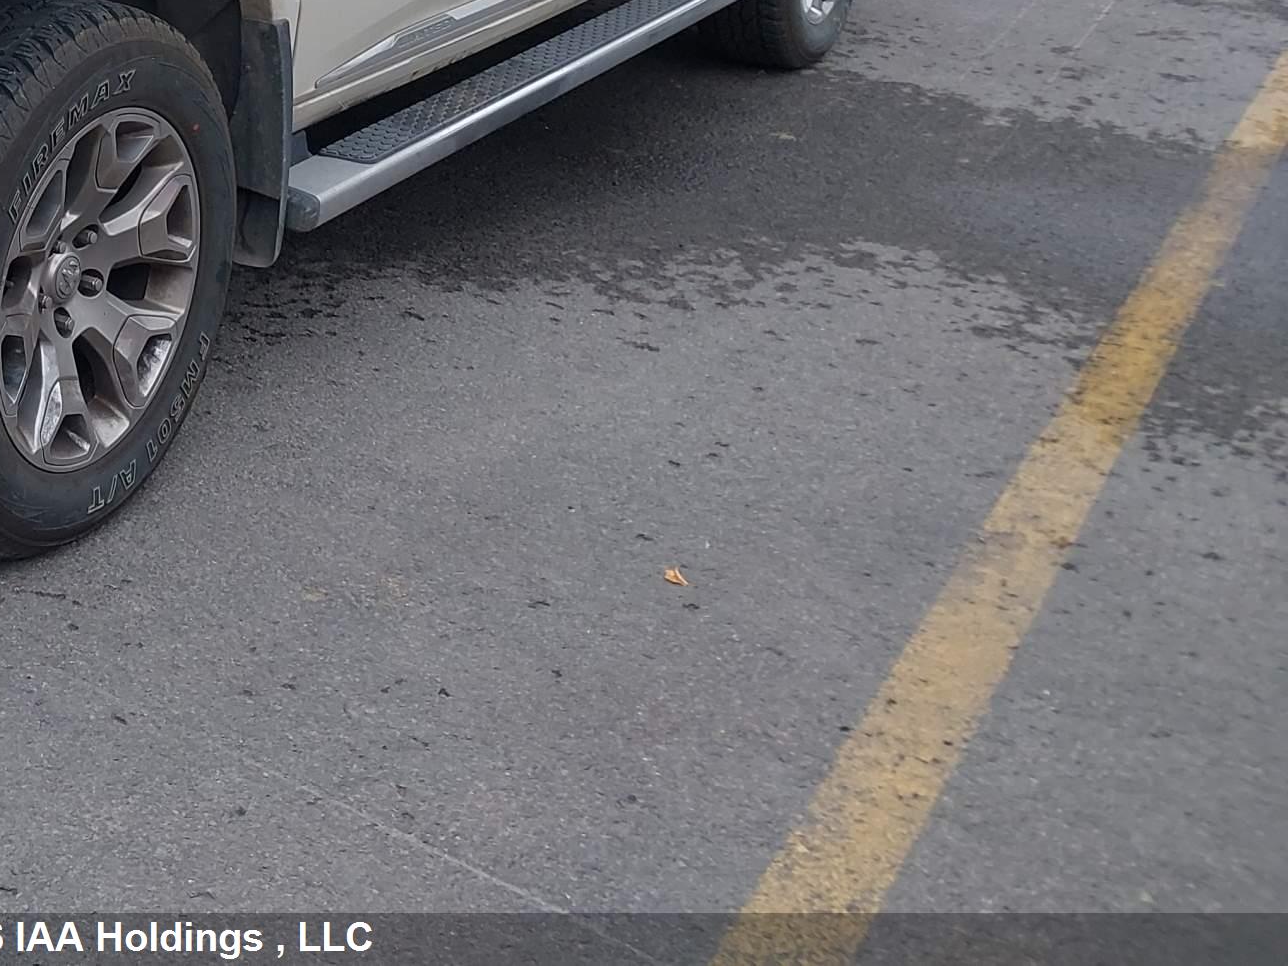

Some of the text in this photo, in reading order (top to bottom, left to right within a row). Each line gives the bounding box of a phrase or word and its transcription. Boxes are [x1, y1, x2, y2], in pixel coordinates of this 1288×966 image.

[8, 68, 137, 224] FIREMAX
[87, 331, 211, 515] FM501 A/T
